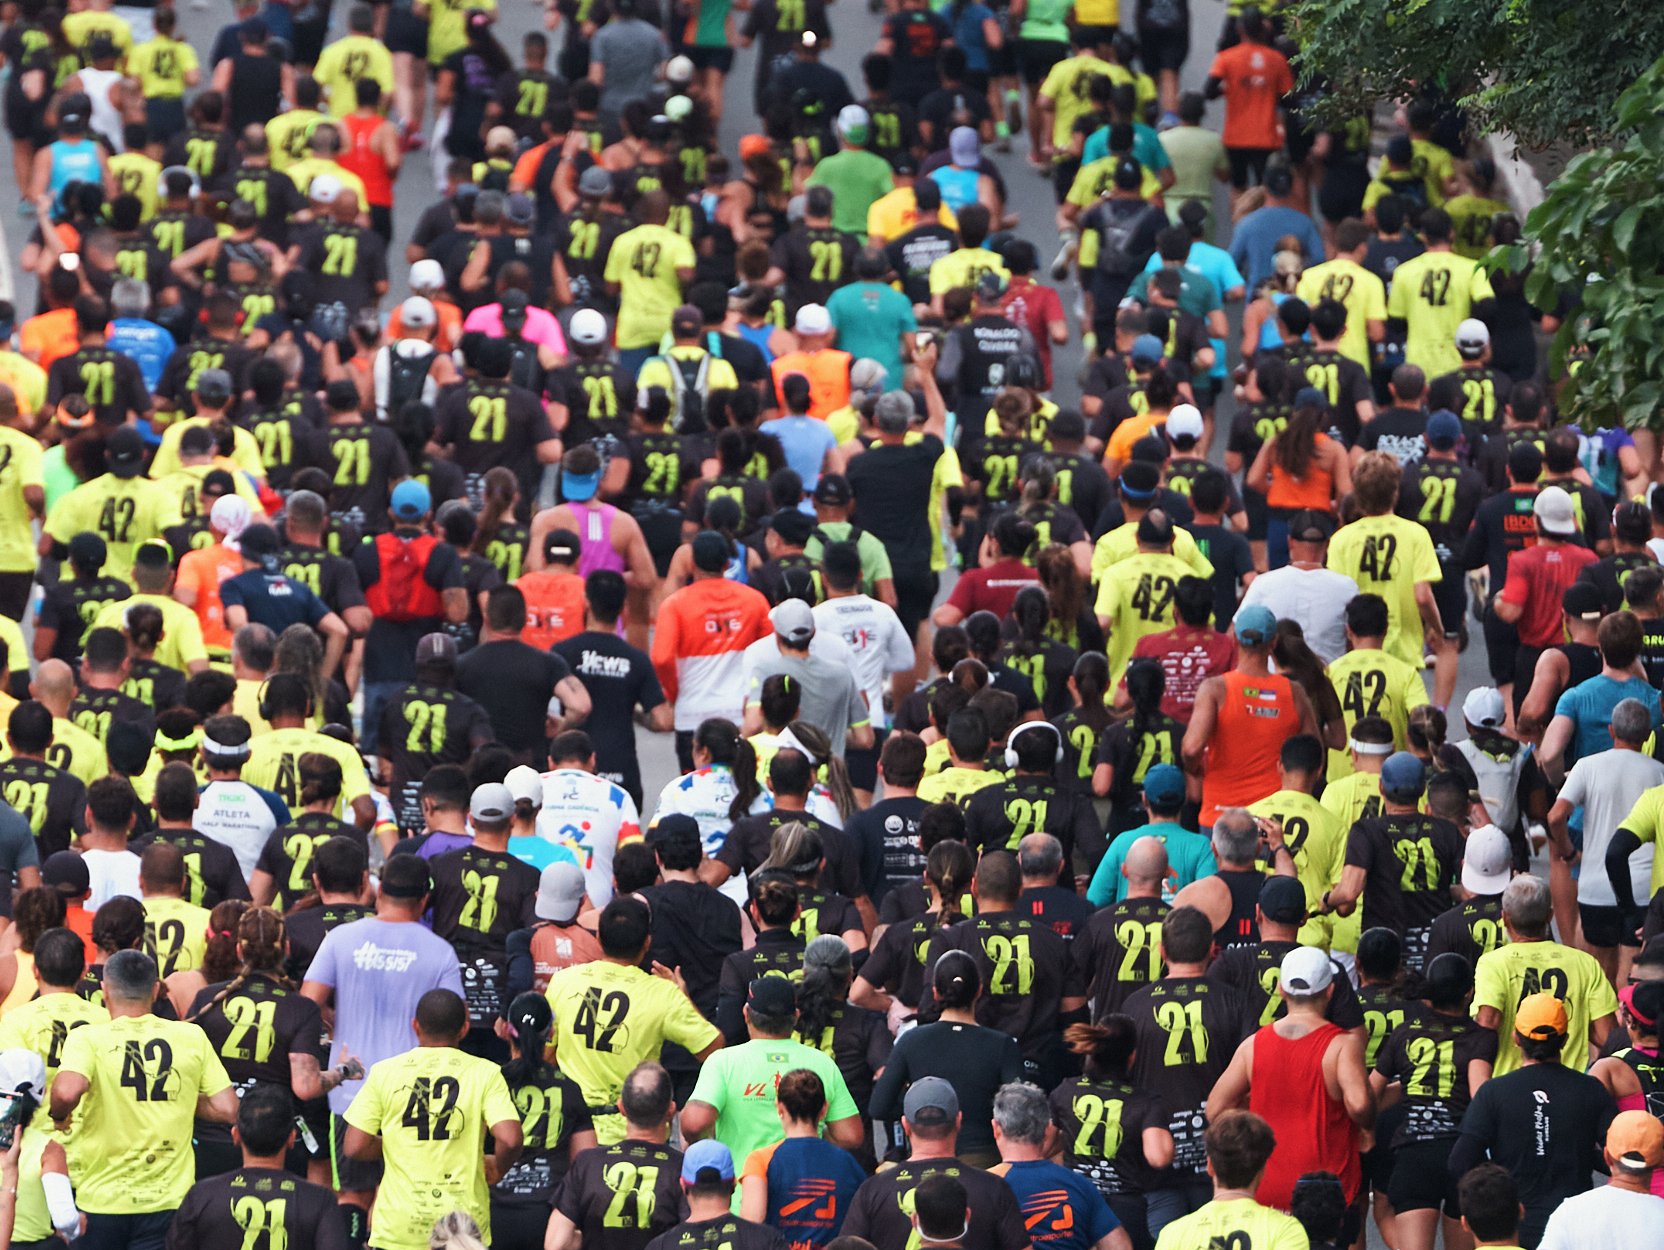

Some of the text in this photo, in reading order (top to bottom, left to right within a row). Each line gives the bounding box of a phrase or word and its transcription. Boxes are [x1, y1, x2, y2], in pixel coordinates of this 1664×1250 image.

[515, 80, 548, 117] 21
[875, 112, 899, 147] 21
[186, 138, 216, 176] 21
[323, 235, 357, 277] 21
[569, 220, 599, 258] 21
[630, 241, 661, 277] 42
[810, 241, 842, 282] 21
[1420, 270, 1450, 306] 42
[80, 362, 115, 406] 21
[583, 376, 617, 418] 21
[1306, 364, 1340, 407] 21
[1462, 379, 1495, 421] 21
[468, 397, 507, 441] 21
[255, 420, 293, 468] 21
[332, 439, 371, 485] 21
[643, 453, 680, 494] 21
[984, 455, 1018, 498] 21
[100, 498, 135, 543] 42
[1418, 476, 1457, 524] 21
[485, 540, 523, 583] 21
[1359, 533, 1397, 582] 42
[1131, 573, 1175, 622] 42
[1343, 670, 1386, 720] 42
[404, 700, 447, 753] 21
[1133, 731, 1176, 784] 21
[7, 780, 49, 836] 21
[213, 809, 250, 818] ATLETA
[1005, 799, 1048, 850] 21
[1393, 837, 1440, 892] 21
[459, 870, 499, 933] 21
[981, 935, 1034, 995] 21
[1115, 921, 1165, 982] 21
[223, 996, 276, 1063] 21
[573, 987, 630, 1053] 42
[1153, 1000, 1209, 1067] 21
[1364, 1011, 1404, 1070] 21
[121, 1038, 173, 1102] 42
[1406, 1038, 1457, 1098] 21
[401, 1076, 460, 1141] 42
[512, 1086, 564, 1149] 21
[1073, 1094, 1123, 1160] 21
[604, 1162, 659, 1229] 21
